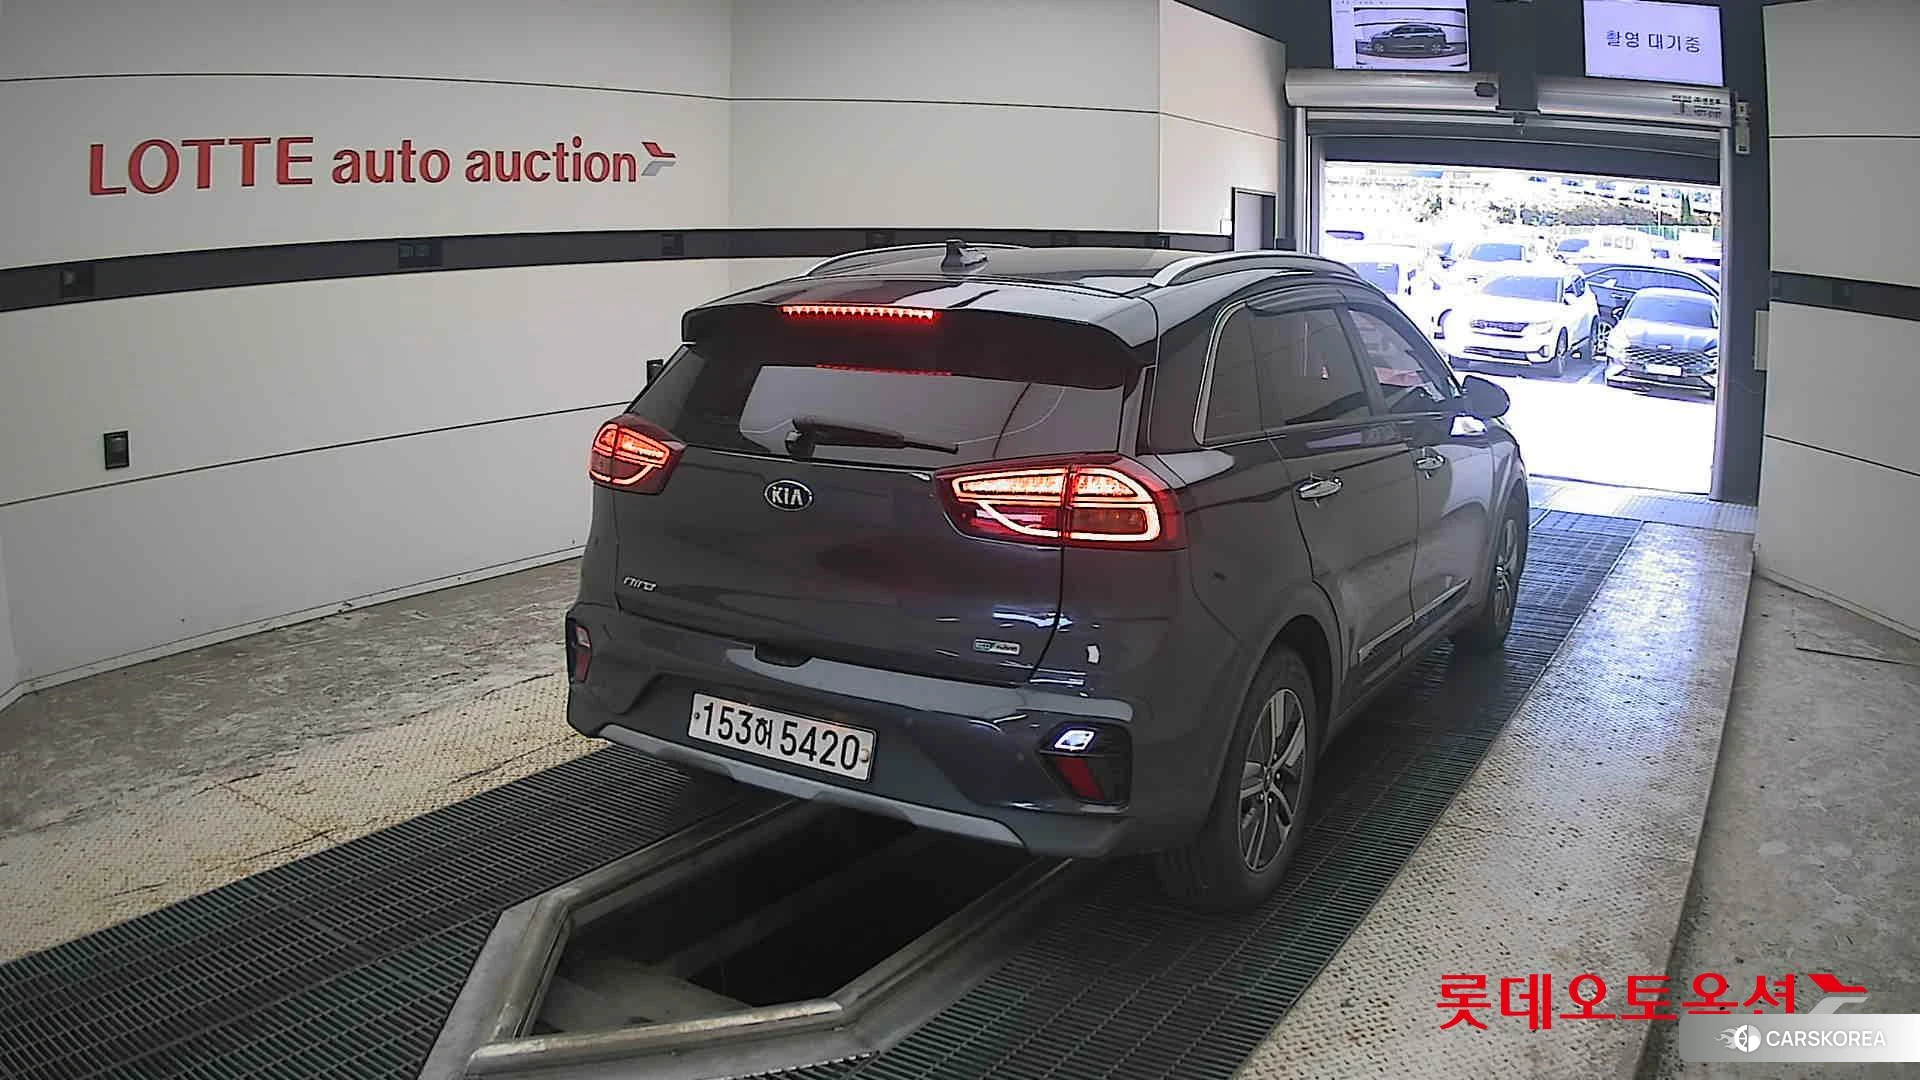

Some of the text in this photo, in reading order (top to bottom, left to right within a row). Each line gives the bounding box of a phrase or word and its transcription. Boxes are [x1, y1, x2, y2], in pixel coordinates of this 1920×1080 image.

[1606, 30, 1701, 54] 촬영 대기중
[89, 136, 637, 196] LOTTE auto auction
[772, 486, 803, 506] KIA
